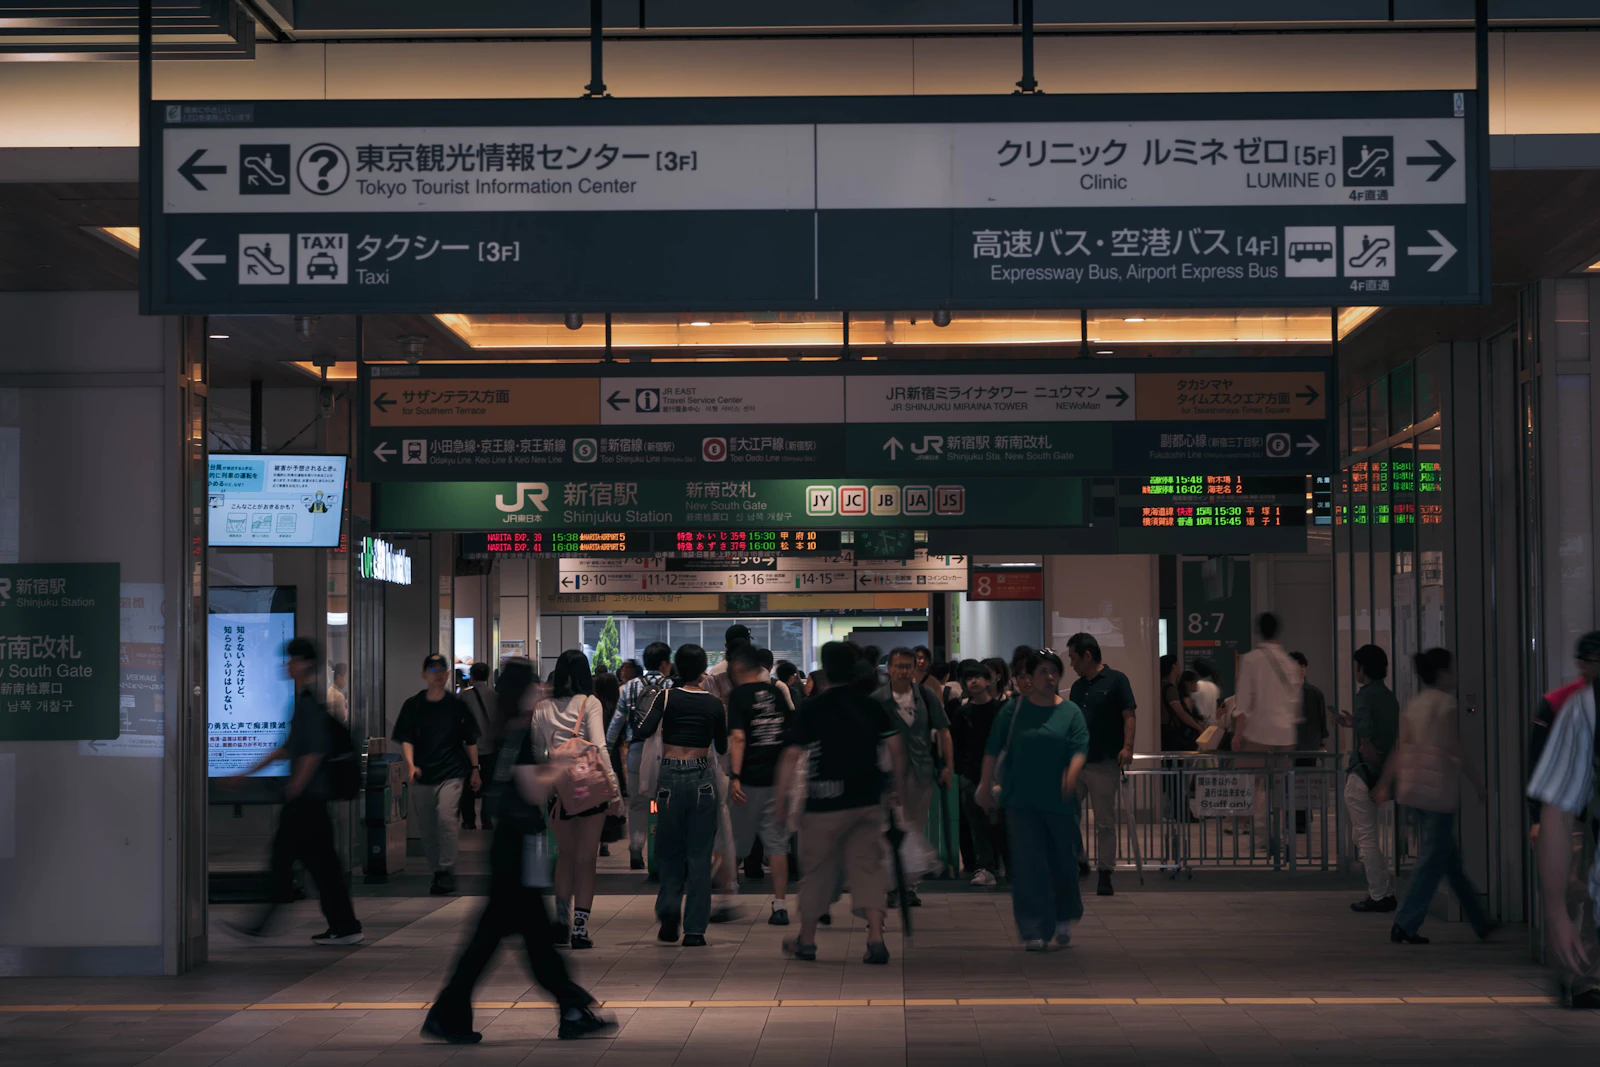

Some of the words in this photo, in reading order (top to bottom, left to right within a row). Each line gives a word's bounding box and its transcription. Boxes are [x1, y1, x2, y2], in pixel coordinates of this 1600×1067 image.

[355, 143, 650, 173] 東京観光情報センター
[656, 151, 698, 171] [3F]
[997, 139, 1128, 167] クリニック
[1294, 145, 1336, 166] [5F]
[1080, 174, 1128, 190] Clinic
[1246, 173, 1317, 189] LUMINE
[355, 179, 407, 198] Tokyo
[412, 178, 470, 195] Tourist
[475, 178, 573, 194] Information
[578, 178, 637, 194] Center
[1349, 189, 1389, 201] 4F直通
[301, 236, 344, 249] TAXI
[355, 234, 470, 262] タクシー
[478, 241, 520, 262] [3F]
[972, 228, 1230, 258] 高速バス・空港バス
[1237, 236, 1279, 256] [4F]
[355, 269, 390, 285] Taxi
[991, 264, 1084, 283] Expressway
[1089, 264, 1123, 282] Bus,
[1126, 263, 1177, 282] Airport
[1181, 263, 1244, 282] Express
[1248, 263, 1279, 279] Bus
[1349, 279, 1390, 291] 4F直通
[1176, 379, 1233, 391] タカシマヤ
[402, 389, 510, 404] サザンテラス方面
[662, 388, 673, 396] JR
[674, 388, 697, 396] EAST
[886, 386, 1028, 400] JR新宿ミライナタワー
[1034, 386, 1100, 399] ニュウマン
[662, 396, 686, 404] Travel
[687, 396, 715, 404] Service
[717, 396, 743, 404] Center
[1176, 392, 1291, 405] タイムズスクエア方面
[402, 407, 413, 416] for
[416, 407, 454, 416] Southern
[455, 407, 487, 416] Terrace
[890, 403, 903, 412] JR
[904, 402, 951, 411] SHINJUKU
[953, 402, 993, 411] MIRAINA
[994, 402, 1028, 411] TOWER
[1055, 402, 1101, 410] NEWoMan
[1264, 406, 1291, 415] Square
[429, 438, 567, 454] 小田急線・京王線・京王新線
[910, 435, 945, 454] JR
[946, 435, 991, 450] 新宿駅
[994, 435, 1053, 450] 新南改札
[429, 456, 455, 466] Odakyu
[491, 455, 506, 465] Line
[507, 455, 514, 464] &
[531, 455, 547, 464] New
[548, 455, 563, 464] Line
[601, 455, 615, 464] Toei
[616, 455, 645, 465] Shinjuku
[645, 455, 661, 464] Line
[730, 454, 744, 464] Toei
[764, 454, 780, 463] Line
[946, 452, 983, 462] Shinjuku
[1004, 452, 1023, 461] New
[1025, 451, 1051, 461] South
[1052, 451, 1075, 461] Gate
[1149, 450, 1188, 459] Fukutoshin
[1188, 450, 1202, 459] Line
[1175, 475, 1203, 484] 15:48
[1236, 475, 1242, 484] 1
[563, 481, 638, 507] 新宿駅
[685, 481, 757, 499] 新南改札
[1175, 485, 1203, 494] 16:02
[1207, 485, 1232, 494] 海老名
[1235, 485, 1242, 494] 2
[495, 481, 550, 512] JR
[812, 494, 830, 507] JY
[845, 494, 862, 507] JC
[877, 494, 894, 507] JB
[908, 494, 927, 507] JA
[942, 494, 957, 507] JS
[685, 501, 709, 511] New
[711, 501, 744, 511] South
[745, 501, 768, 511] Gate
[1142, 507, 1174, 516] 東海道線
[1177, 507, 1193, 516] 快速
[1196, 507, 1212, 515] 15両
[1214, 506, 1242, 516] 15:30
[1275, 507, 1281, 516] 1
[502, 514, 543, 523] JR東日本
[563, 509, 622, 525] Shinjuku
[625, 509, 673, 523] Station
[1142, 517, 1174, 526] 横須賀線
[1196, 517, 1212, 526] 10両
[1214, 517, 1242, 526] 15:45
[1275, 517, 1281, 526] 1
[487, 532, 513, 541] NARITA
[514, 532, 531, 541] EXP.
[533, 532, 543, 541] 39
[552, 532, 579, 541] 15:38
[619, 532, 626, 541] 5
[676, 531, 693, 540] 特急
[730, 531, 747, 540] 35号
[748, 531, 776, 540] 15:30
[806, 531, 817, 540] 10
[487, 542, 513, 552] NARITA
[514, 542, 531, 552] EXP.
[533, 542, 543, 552] 41
[552, 542, 579, 552] 16:08
[619, 542, 626, 552] 5
[676, 541, 693, 551] 特急
[730, 541, 747, 551] 37号
[748, 541, 776, 551] 16:00
[806, 541, 817, 551] 10
[581, 574, 607, 586] 9·10
[648, 573, 678, 585] 11·12
[734, 573, 765, 585] 13·16
[801, 573, 833, 585] 14·15
[16, 578, 66, 595] 新宿駅
[977, 576, 992, 596] 8
[16, 597, 58, 609] Shinjuku
[61, 597, 95, 607] Station
[1187, 612, 1225, 634] 8·7
[236, 625, 246, 699] 知らない人だけど、
[8, 664, 52, 678] South
[57, 664, 93, 678] Gate
[223, 625, 233, 716] 知らないふりはしない。
[8, 700, 32, 713] 남쪽
[36, 700, 74, 712] 개찰구
[1198, 777, 1238, 787] 関係者以外の
[1204, 788, 1252, 798] 通行は出来ません
[1200, 800, 1227, 808] Staff
[1229, 800, 1253, 809] only
